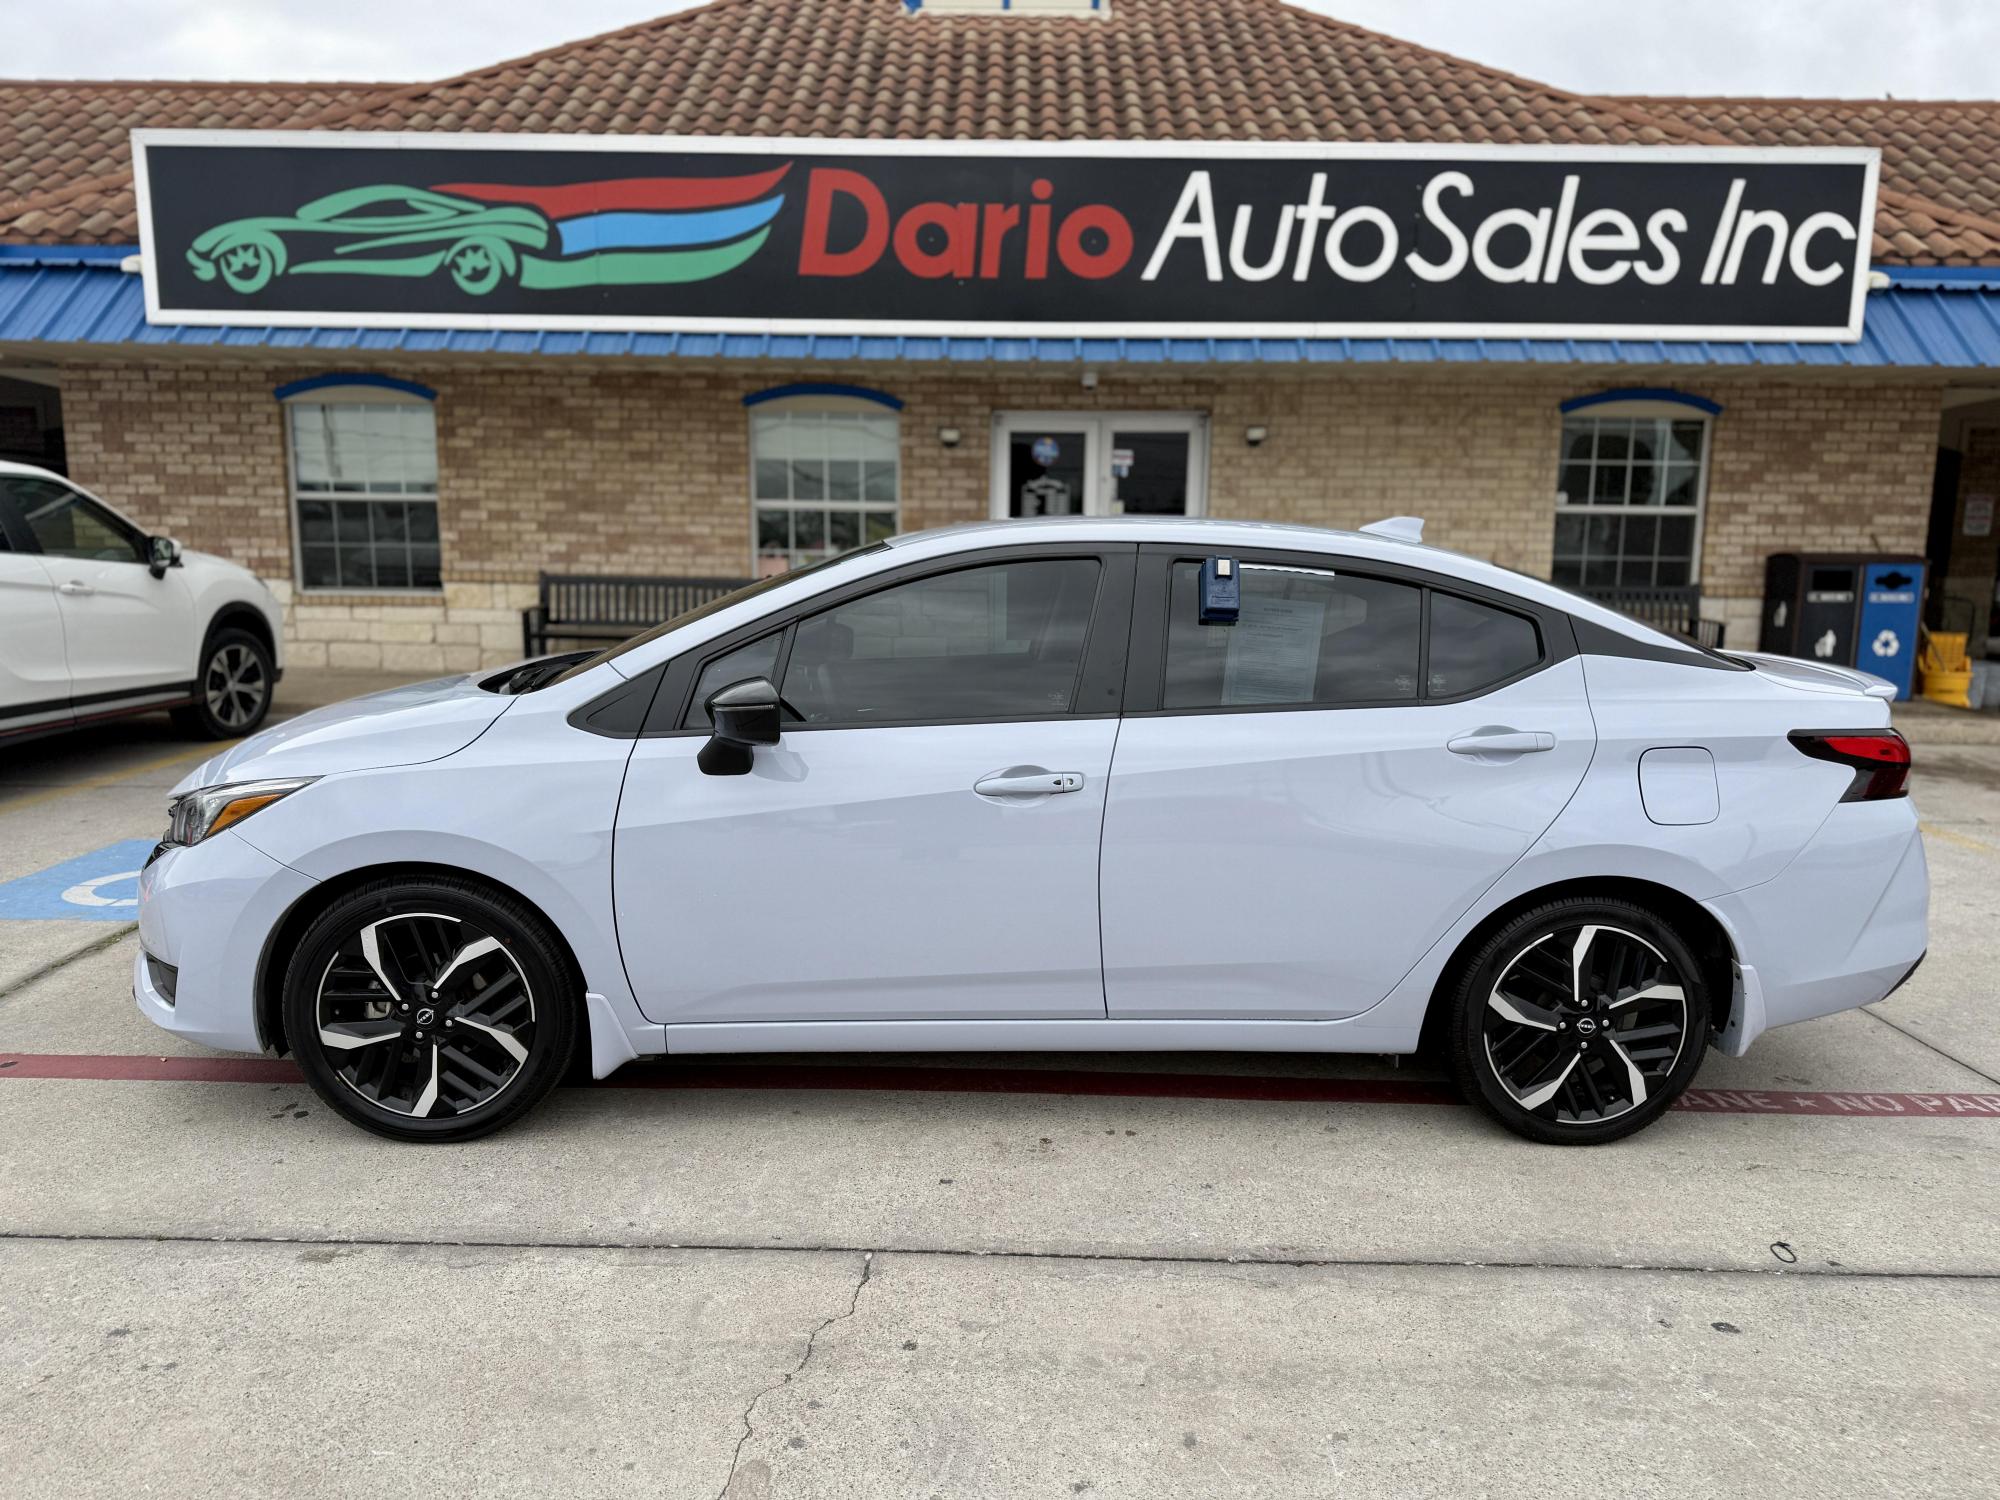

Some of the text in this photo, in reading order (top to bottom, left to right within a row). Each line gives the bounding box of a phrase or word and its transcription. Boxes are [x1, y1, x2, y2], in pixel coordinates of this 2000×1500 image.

[797, 167, 1858, 286] Dario Auto Sales Inc
[1672, 1090, 1783, 1110] ANE
[1822, 1093, 1905, 1112] NO
